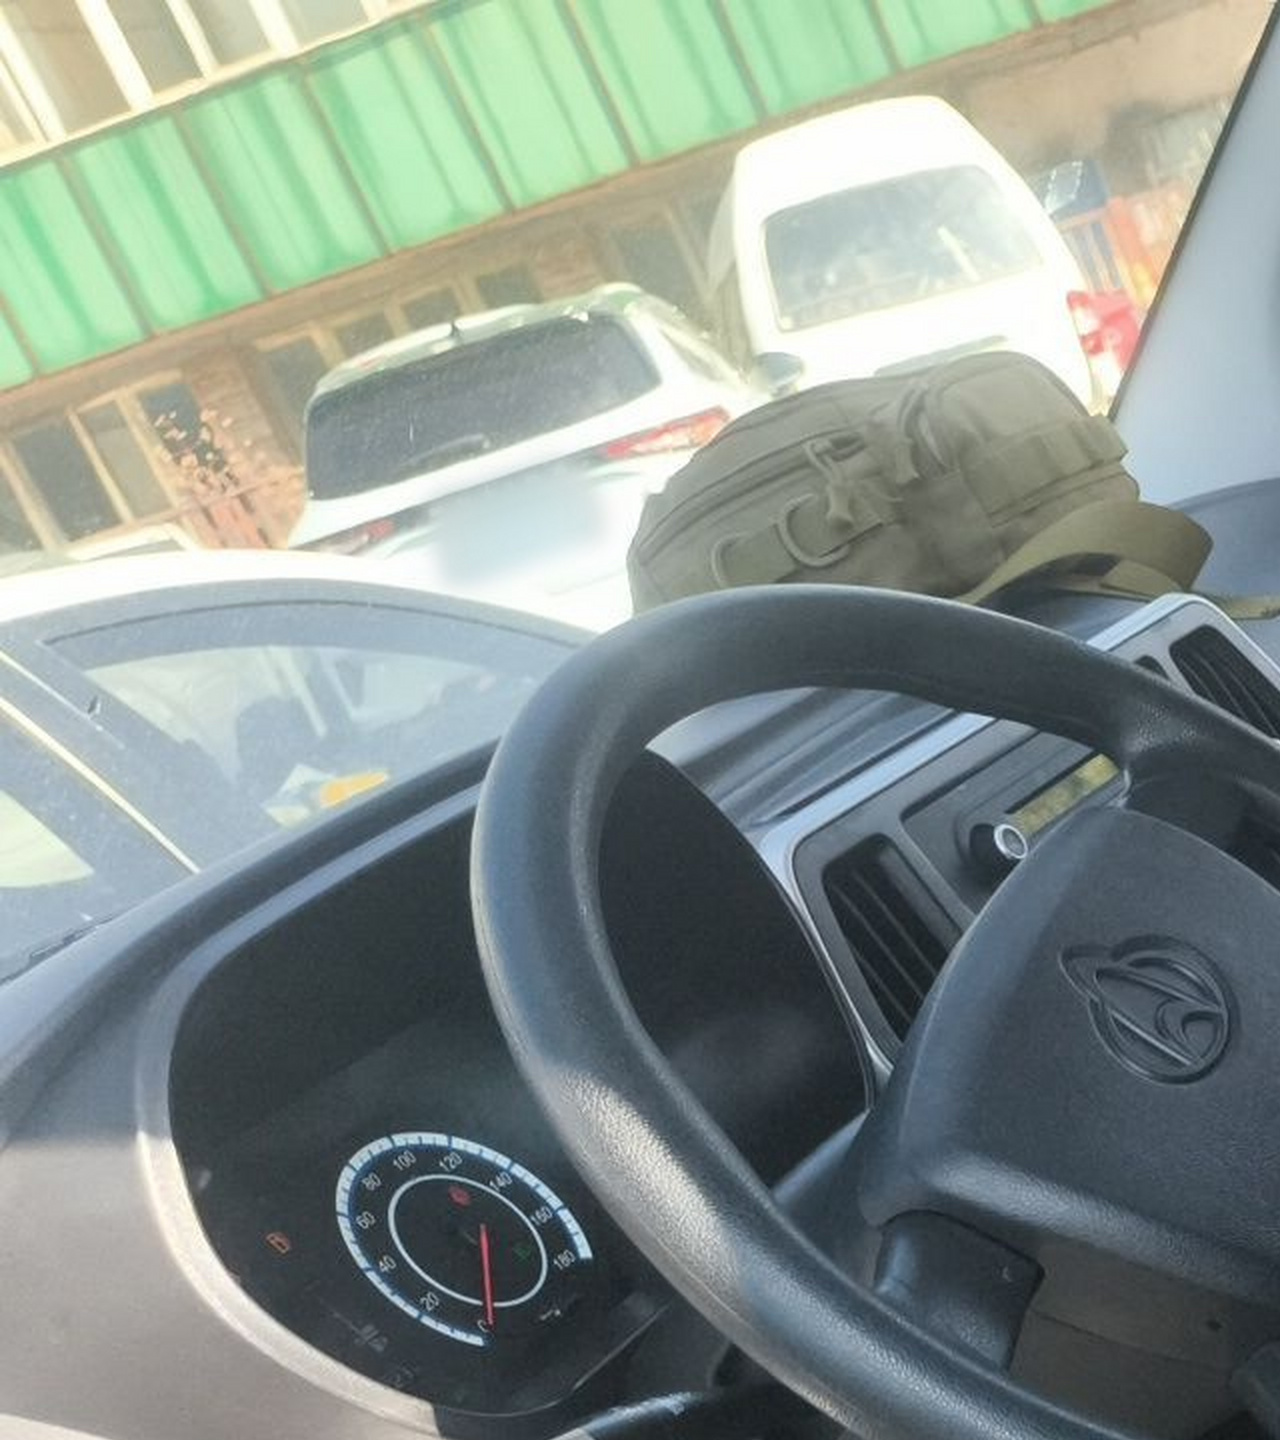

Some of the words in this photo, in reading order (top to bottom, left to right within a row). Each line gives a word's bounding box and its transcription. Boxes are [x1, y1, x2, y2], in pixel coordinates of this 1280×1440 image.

[392, 1150, 417, 1171] 100
[438, 1151, 463, 1172] 120
[361, 1172, 382, 1191] 80
[489, 1171, 513, 1193] 140
[355, 1210, 376, 1229] 60
[530, 1205, 553, 1226] 160
[378, 1254, 397, 1273] 40
[553, 1249, 576, 1271] 180
[419, 1291, 440, 1311] 20
